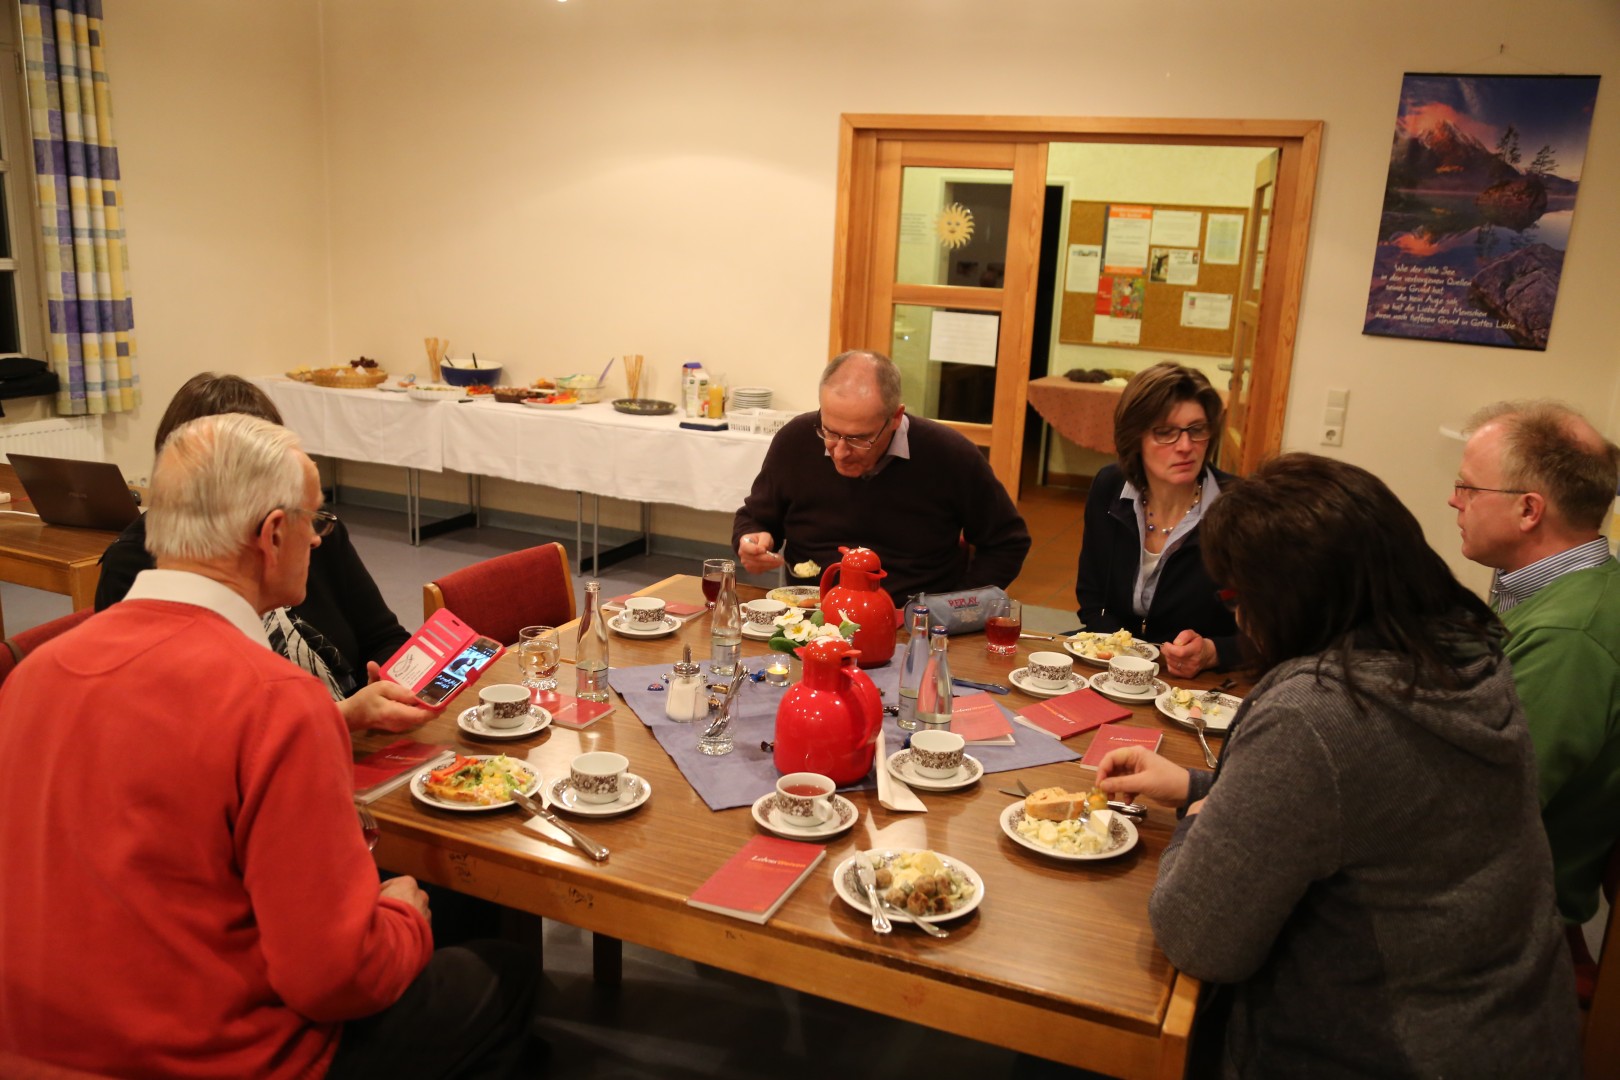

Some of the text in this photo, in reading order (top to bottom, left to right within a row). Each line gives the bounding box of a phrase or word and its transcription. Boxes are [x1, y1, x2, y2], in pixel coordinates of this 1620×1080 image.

[1410, 265, 1422, 273] der
[1446, 277, 1473, 287] Quellen
[1408, 284, 1431, 293] Grund
[1452, 306, 1488, 317] Menschen
[1470, 318, 1494, 328] Gottes
[1495, 320, 1516, 330] Liebe
